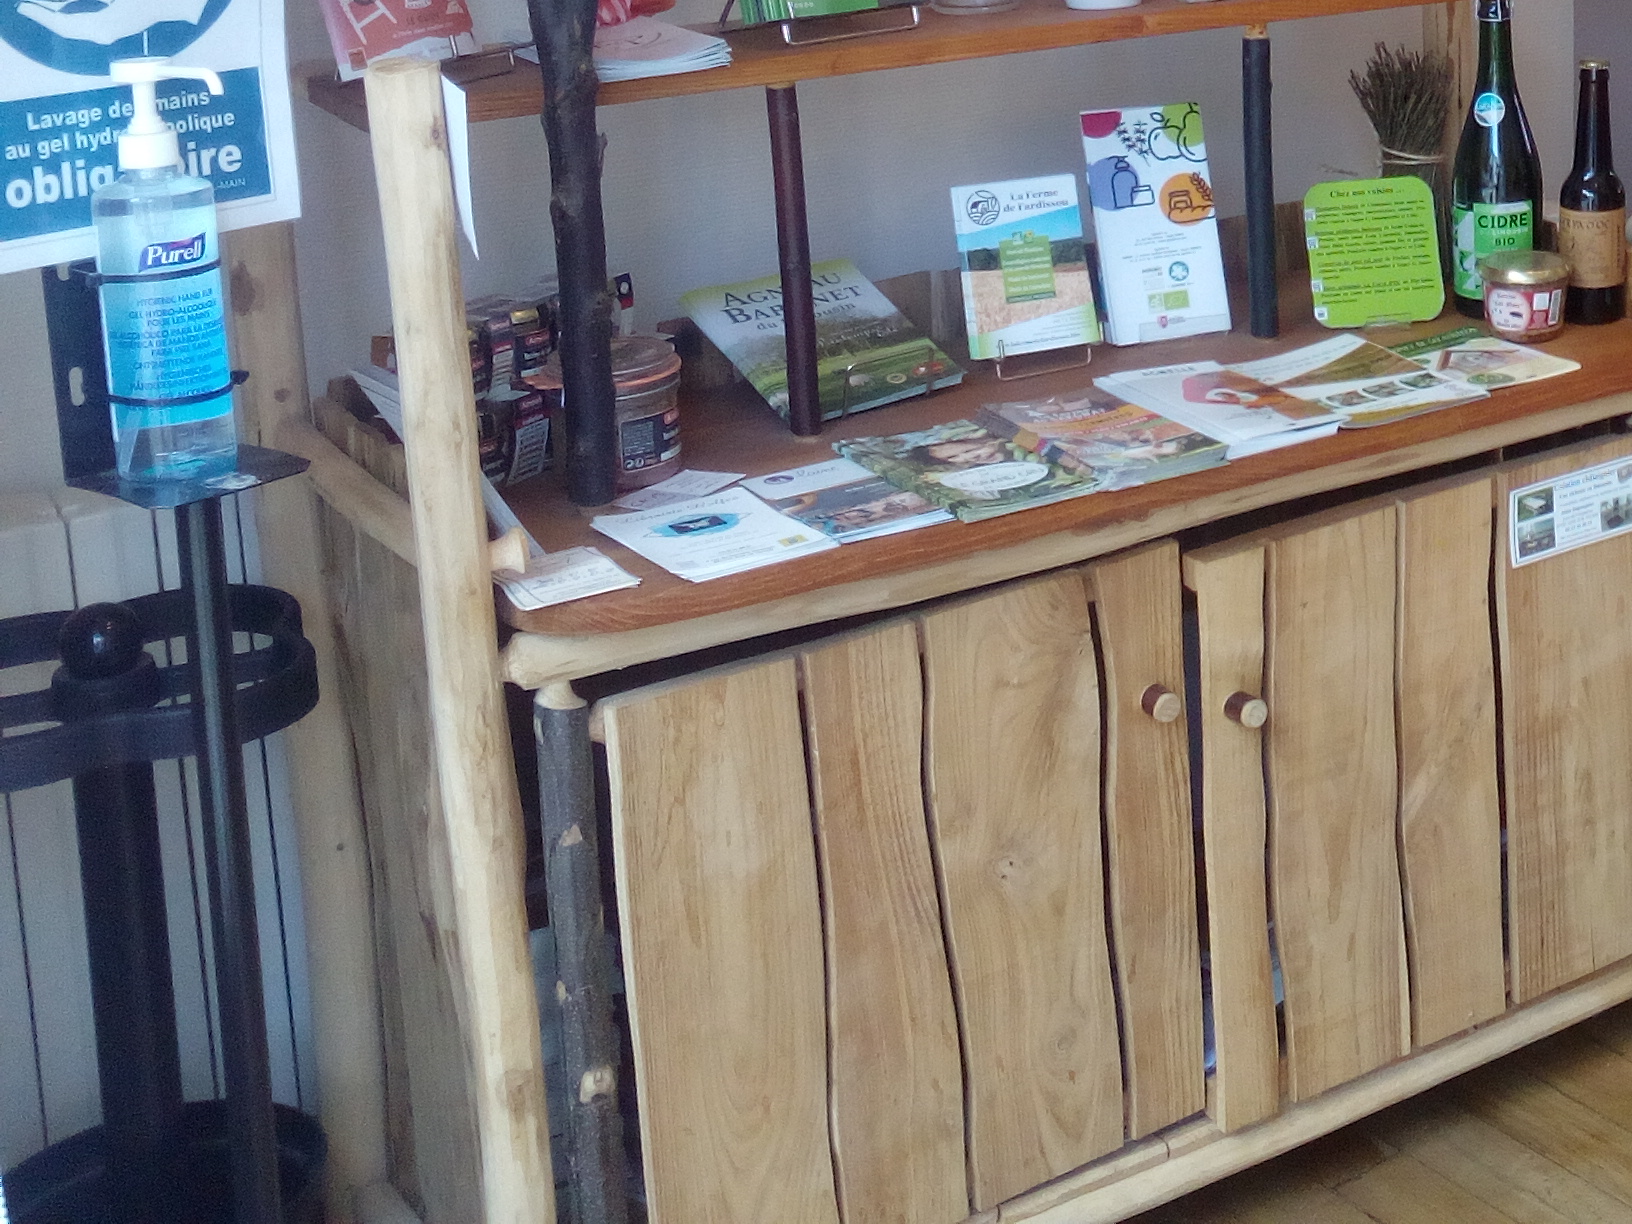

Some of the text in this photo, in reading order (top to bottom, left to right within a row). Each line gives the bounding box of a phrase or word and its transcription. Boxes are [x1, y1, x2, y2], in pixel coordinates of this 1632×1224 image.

[26, 106, 102, 132] Lavage
[155, 89, 211, 113] mains
[5, 142, 31, 160] au
[37, 132, 70, 160] gel
[1026, 189, 1059, 200] Ferme
[1004, 204, 1017, 212] de
[1478, 212, 1528, 229] CIDRE
[1495, 237, 1515, 247] BIO
[147, 241, 202, 266] Purell
